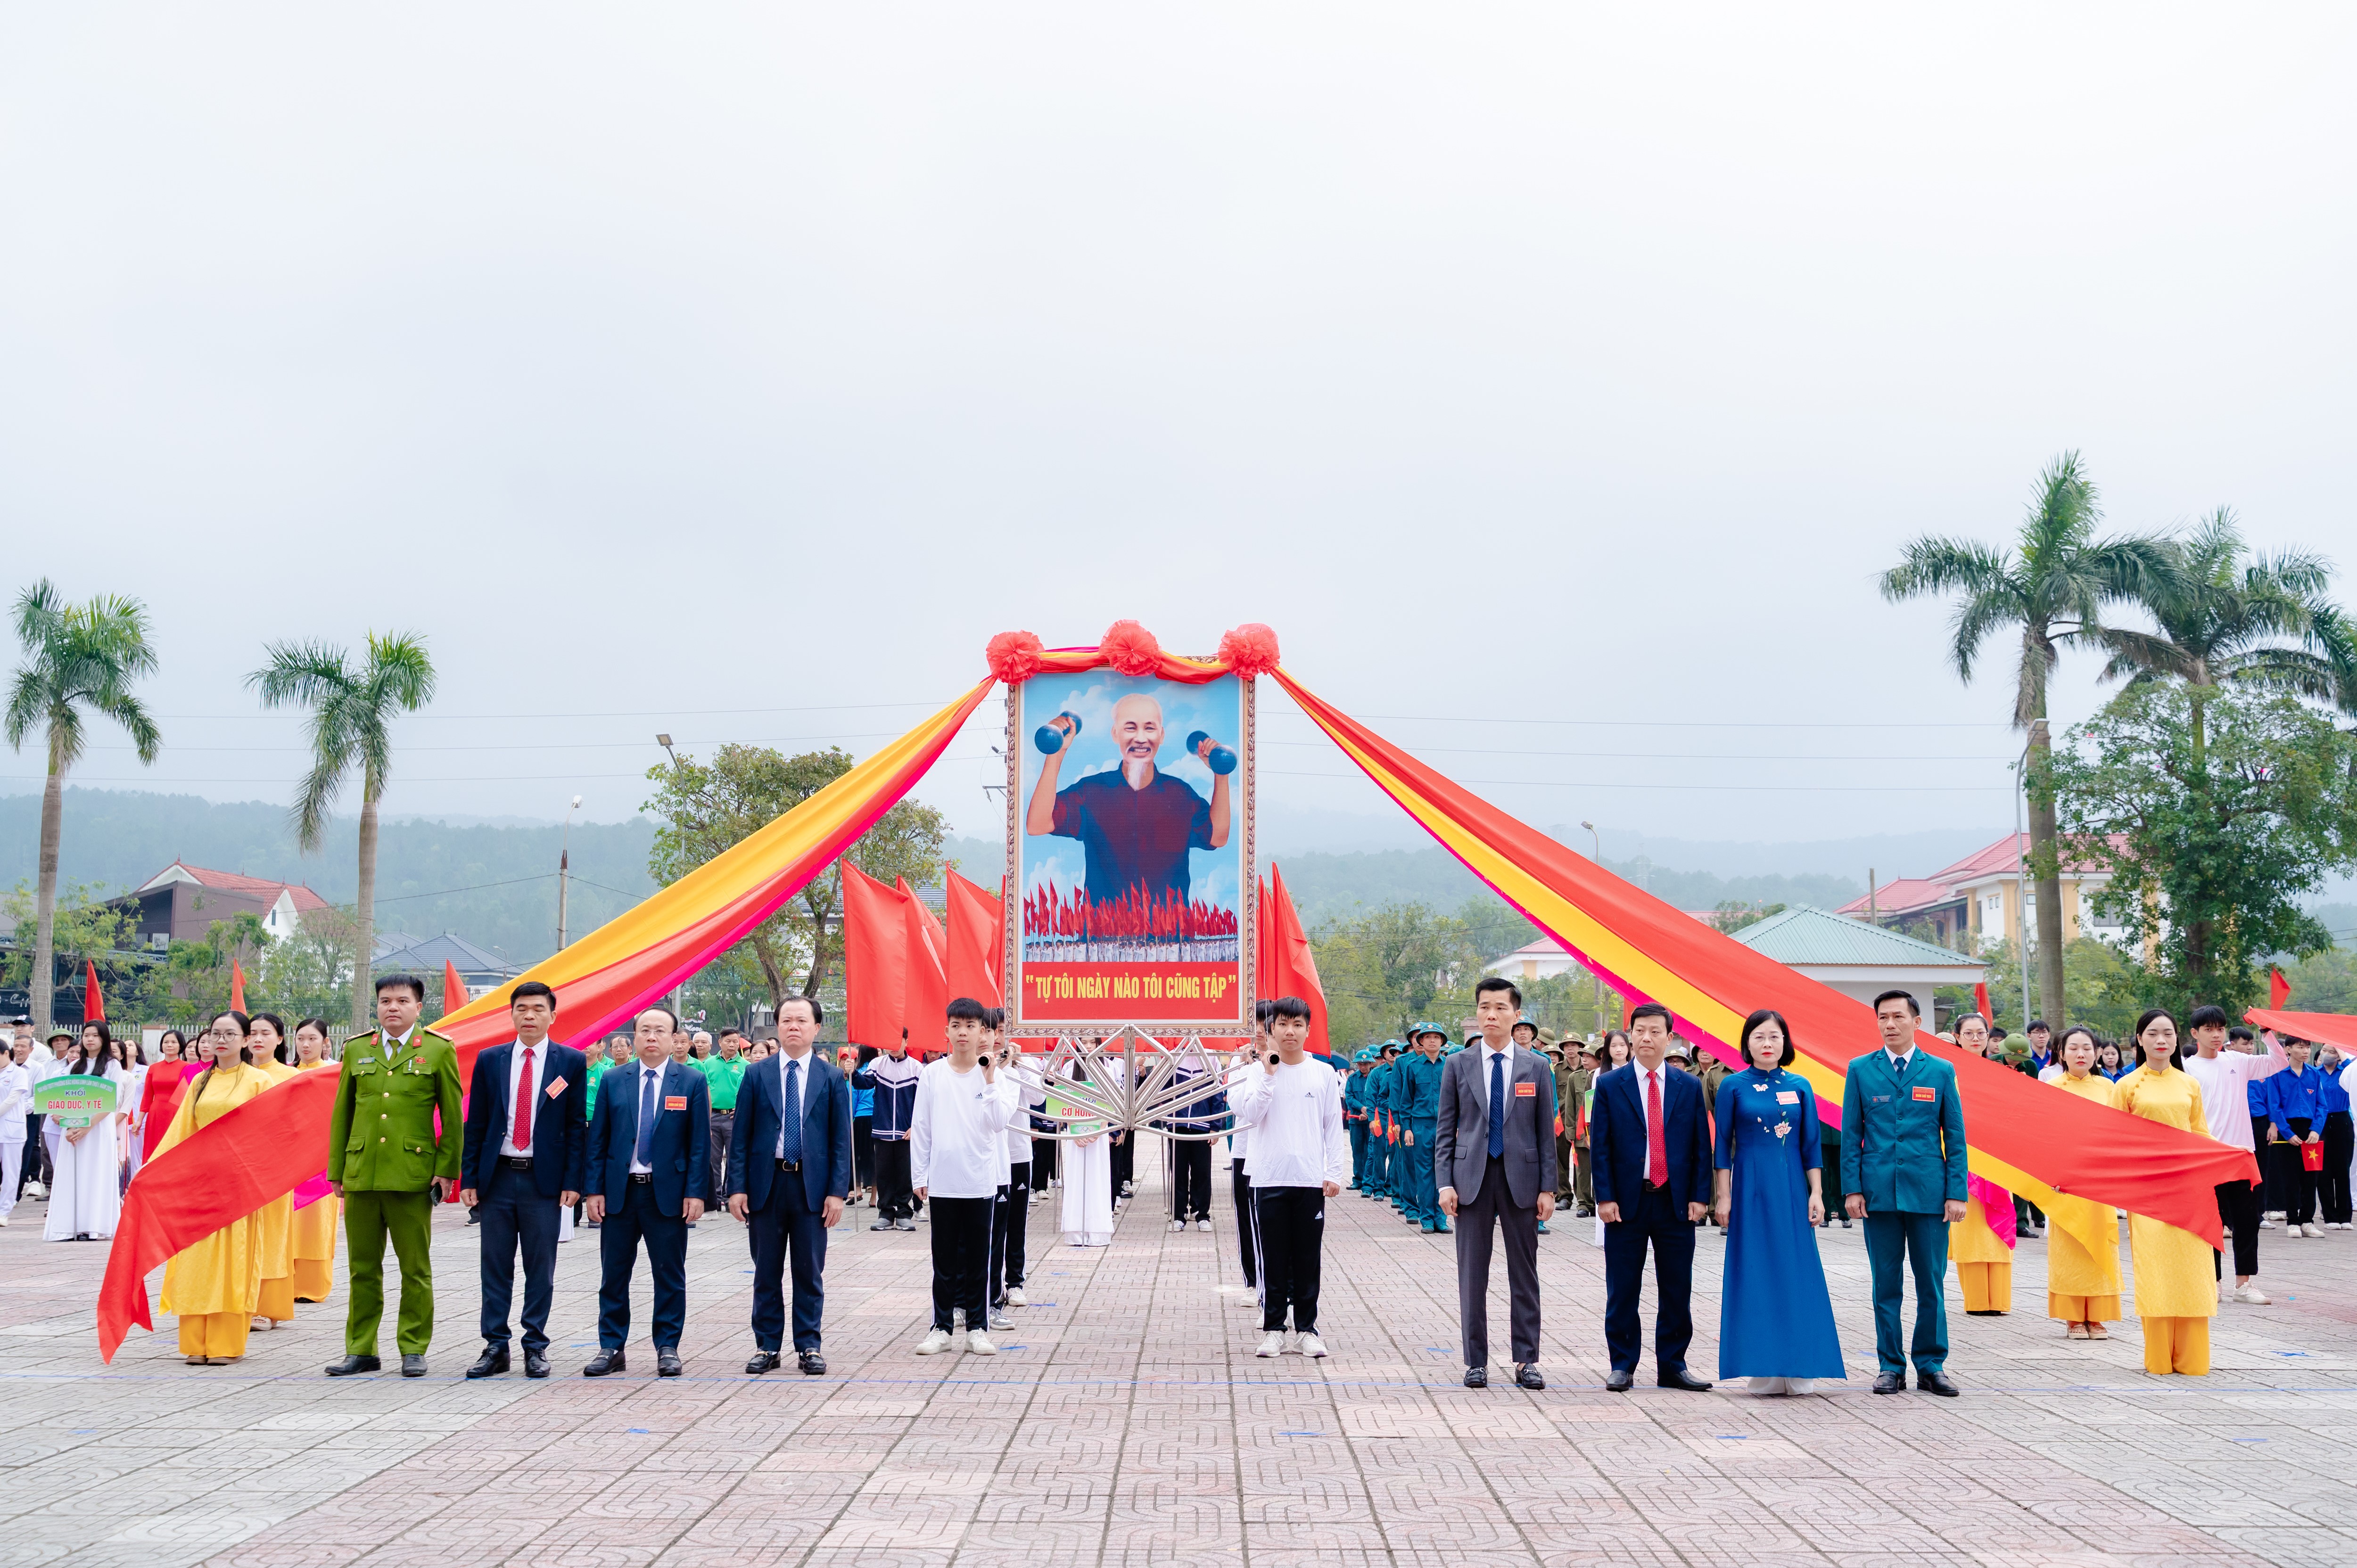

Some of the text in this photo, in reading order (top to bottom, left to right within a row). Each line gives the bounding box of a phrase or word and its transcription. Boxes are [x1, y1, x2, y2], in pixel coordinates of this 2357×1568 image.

[1054, 972, 1073, 998] TÔI
[1077, 972, 1111, 998] NGÀY
[1114, 972, 1139, 998] NÀO
[1143, 972, 1162, 998] TÔI
[1166, 972, 1200, 998] CŨNG
[65, 1087, 85, 1096] KHỐI
[48, 1098, 102, 1110] GIÁO DỤC, Y TẾ
[1062, 1105, 1072, 1116] CỜ
